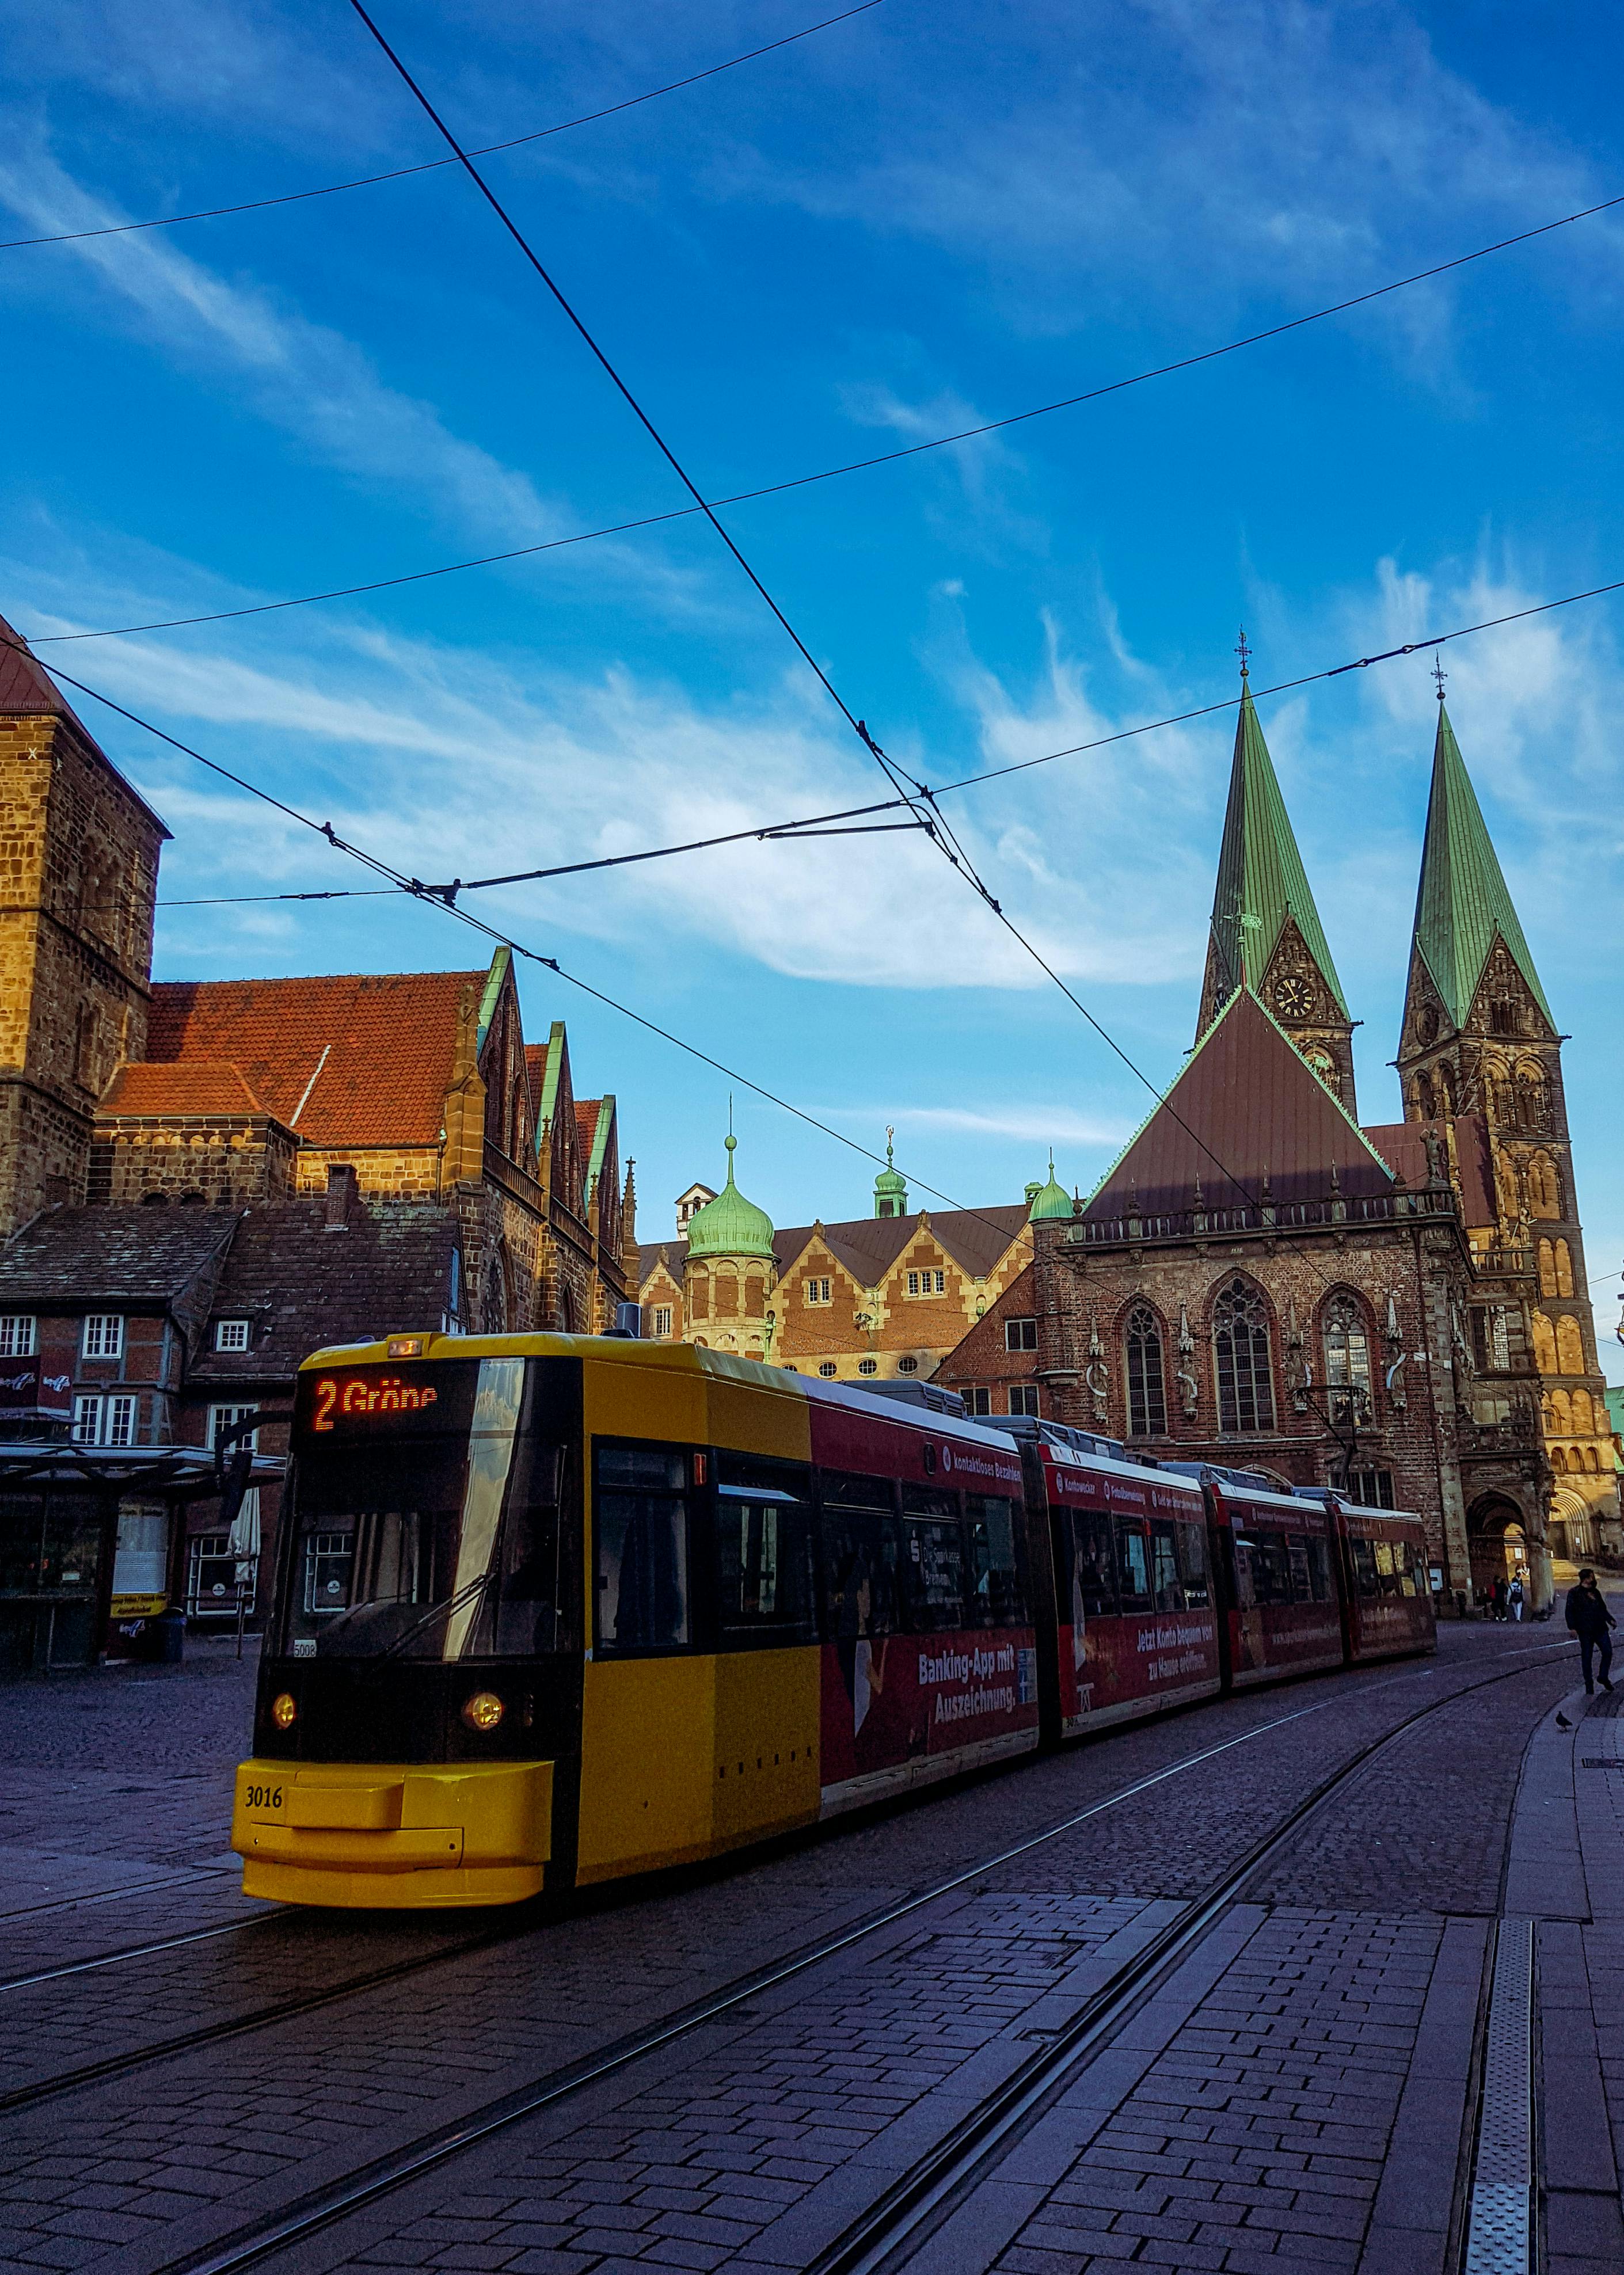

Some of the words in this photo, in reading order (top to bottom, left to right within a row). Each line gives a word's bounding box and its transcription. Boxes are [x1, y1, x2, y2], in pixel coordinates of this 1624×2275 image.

[315, 1381, 336, 1430] 2
[953, 1451, 994, 1477] kontaktloses
[995, 1462, 1021, 1482] Bezahlen
[295, 1644, 315, 1656] 5008
[1137, 1629, 1156, 1652] Jetzt
[1156, 1626, 1177, 1649] Konto
[918, 1648, 995, 1686] Banking-App
[997, 1643, 1015, 1673] mit
[934, 1684, 1016, 1725] Auszeichnung.
[245, 1785, 282, 1808] 3016
